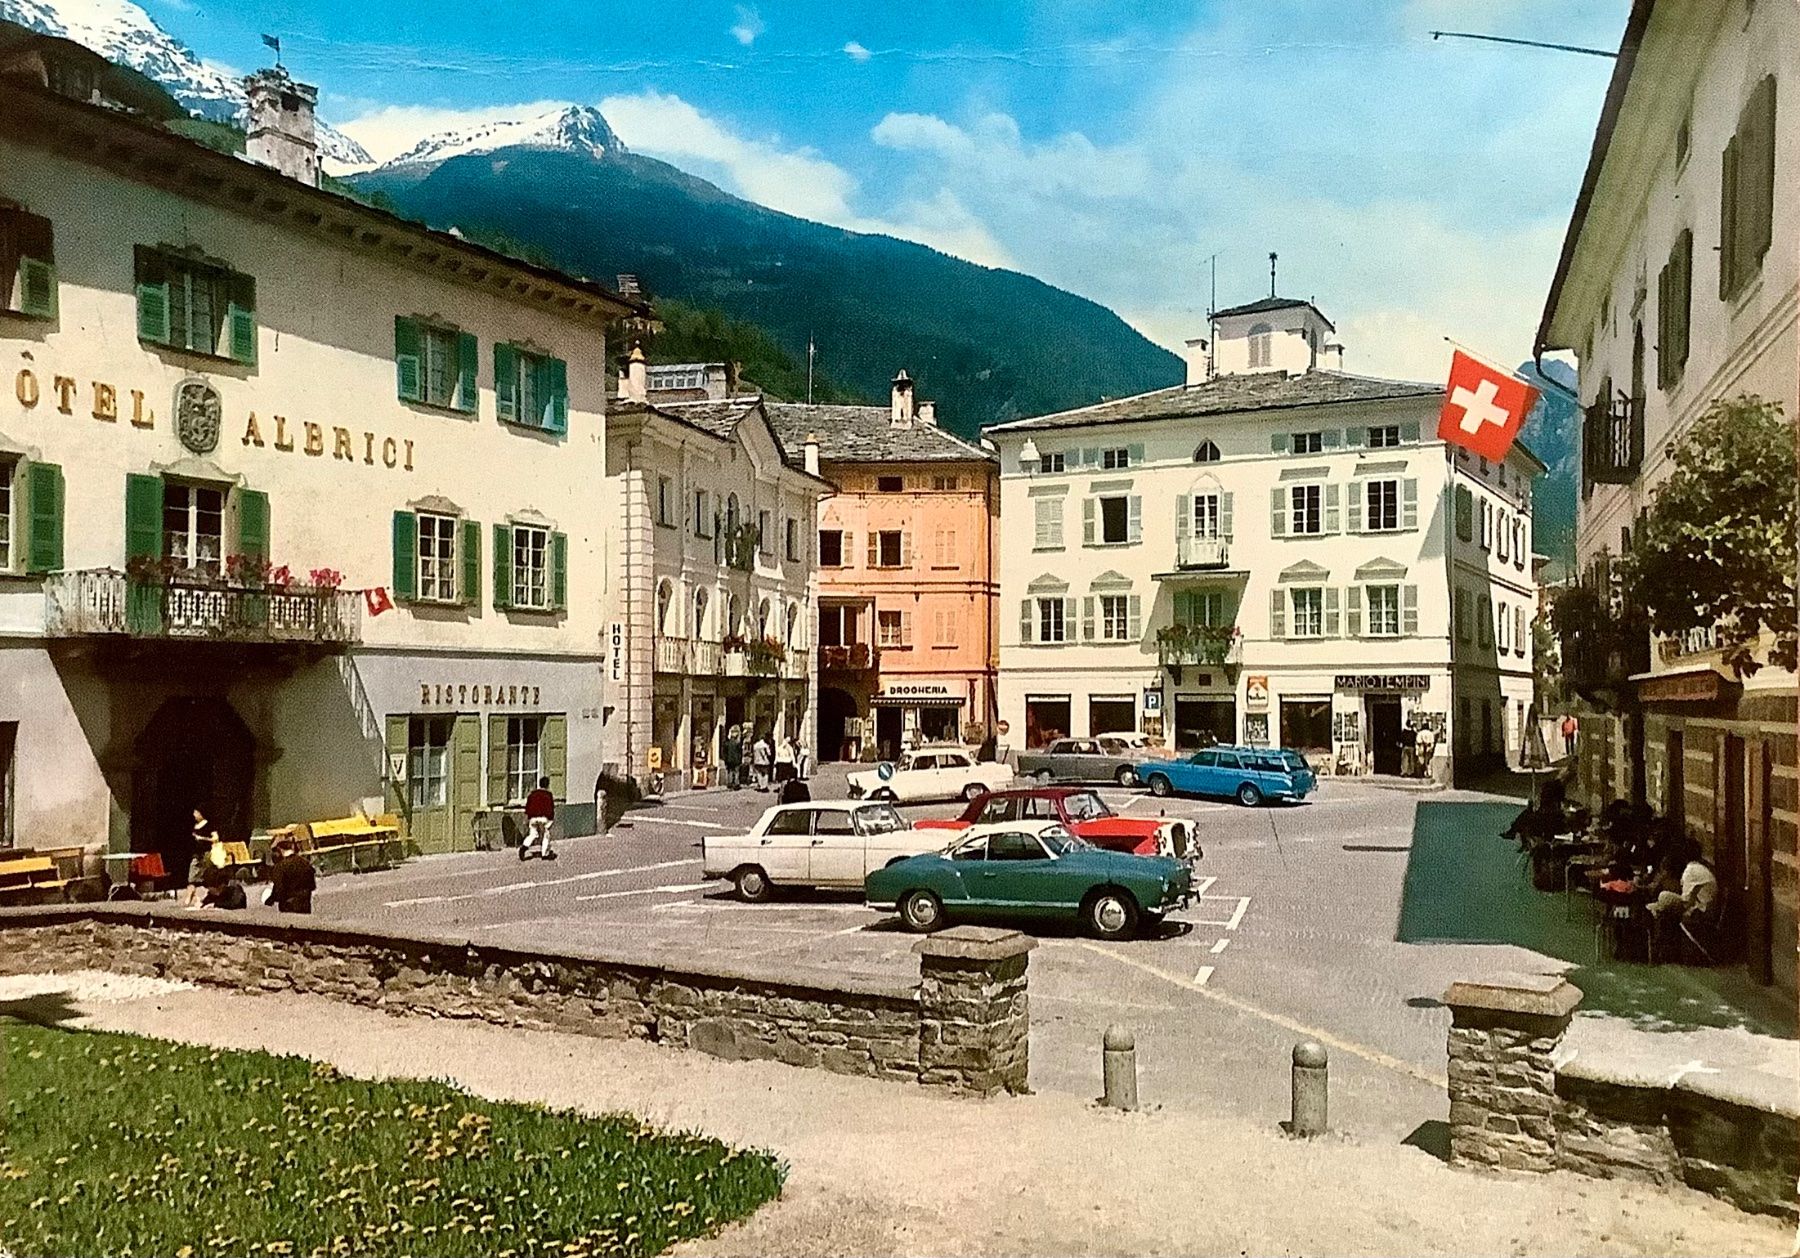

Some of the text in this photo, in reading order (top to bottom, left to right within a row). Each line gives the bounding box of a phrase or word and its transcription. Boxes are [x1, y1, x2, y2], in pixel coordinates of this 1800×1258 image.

[241, 411, 414, 471] ALBRICI
[612, 623, 621, 680] HOTEL
[889, 686, 948, 695] DROGHERIA
[1336, 674, 1430, 689] MARIO TEMPINI
[421, 684, 540, 705] RISTORANTE
[1148, 695, 1157, 709] P
